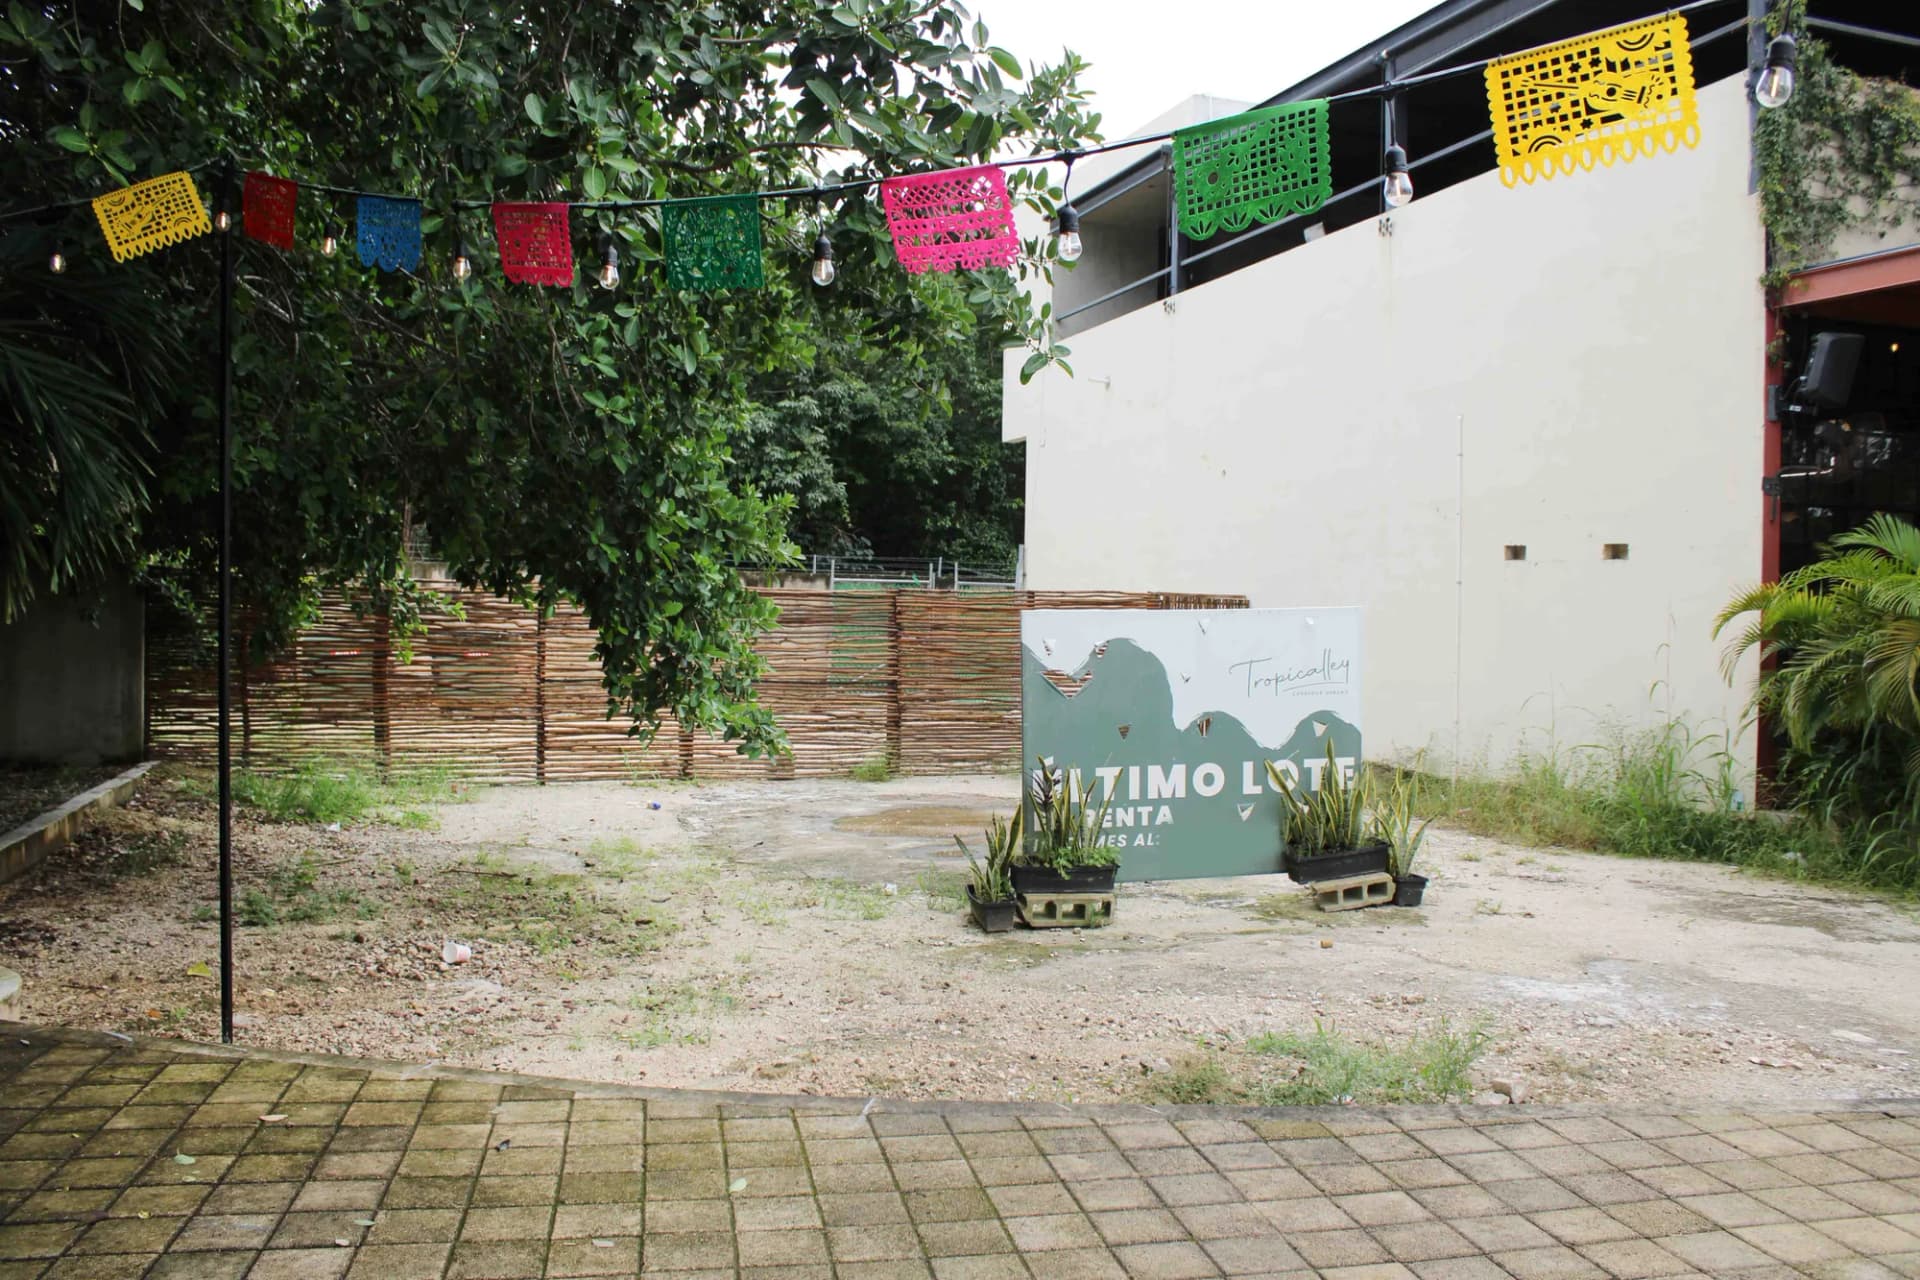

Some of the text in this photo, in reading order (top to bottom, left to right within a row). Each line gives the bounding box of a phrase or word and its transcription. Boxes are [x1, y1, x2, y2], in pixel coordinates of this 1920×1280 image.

[913, 201, 976, 219] CINCO
[922, 229, 983, 247] MAYO
[1228, 648, 1350, 698] Tropicalley
[1242, 757, 1355, 794] LOTE
